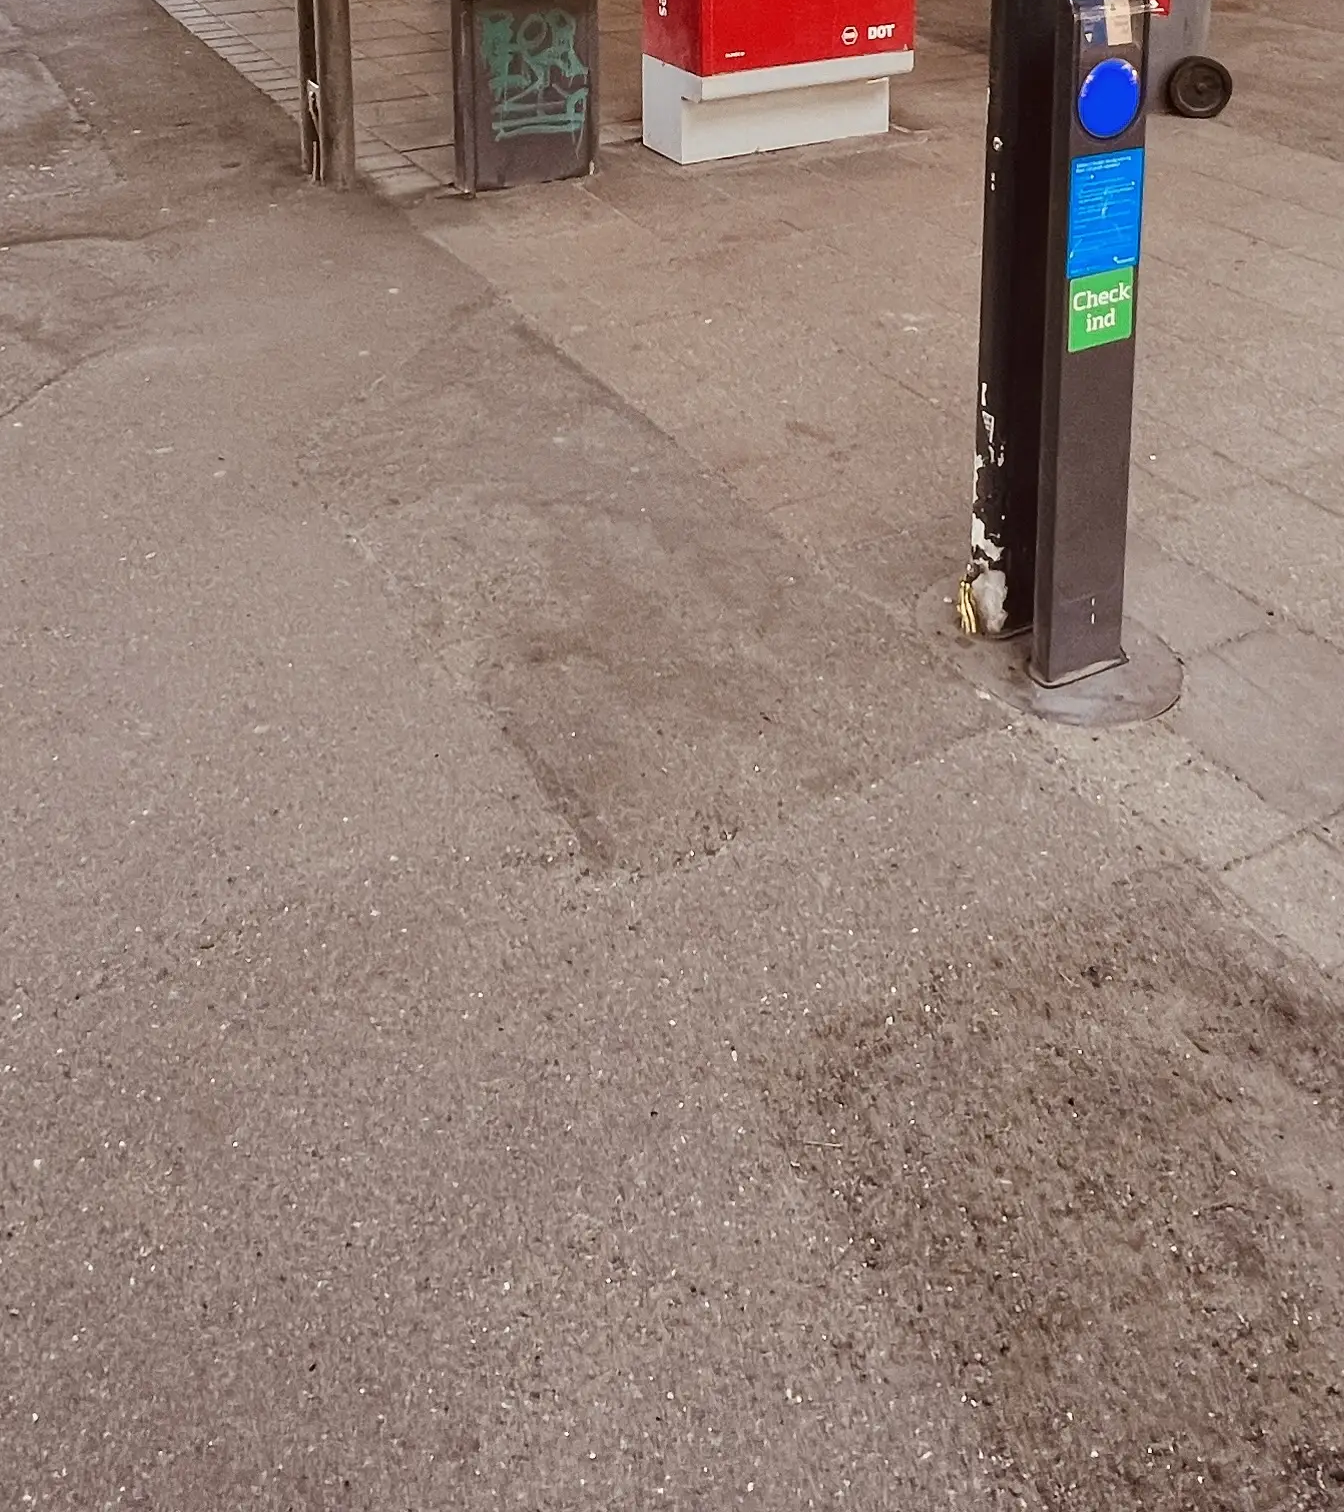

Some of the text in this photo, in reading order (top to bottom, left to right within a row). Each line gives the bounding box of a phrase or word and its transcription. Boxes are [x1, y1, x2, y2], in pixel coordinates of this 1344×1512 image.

[867, 23, 896, 40] DOT
[1072, 281, 1133, 312] Check
[1086, 307, 1116, 332] ind
